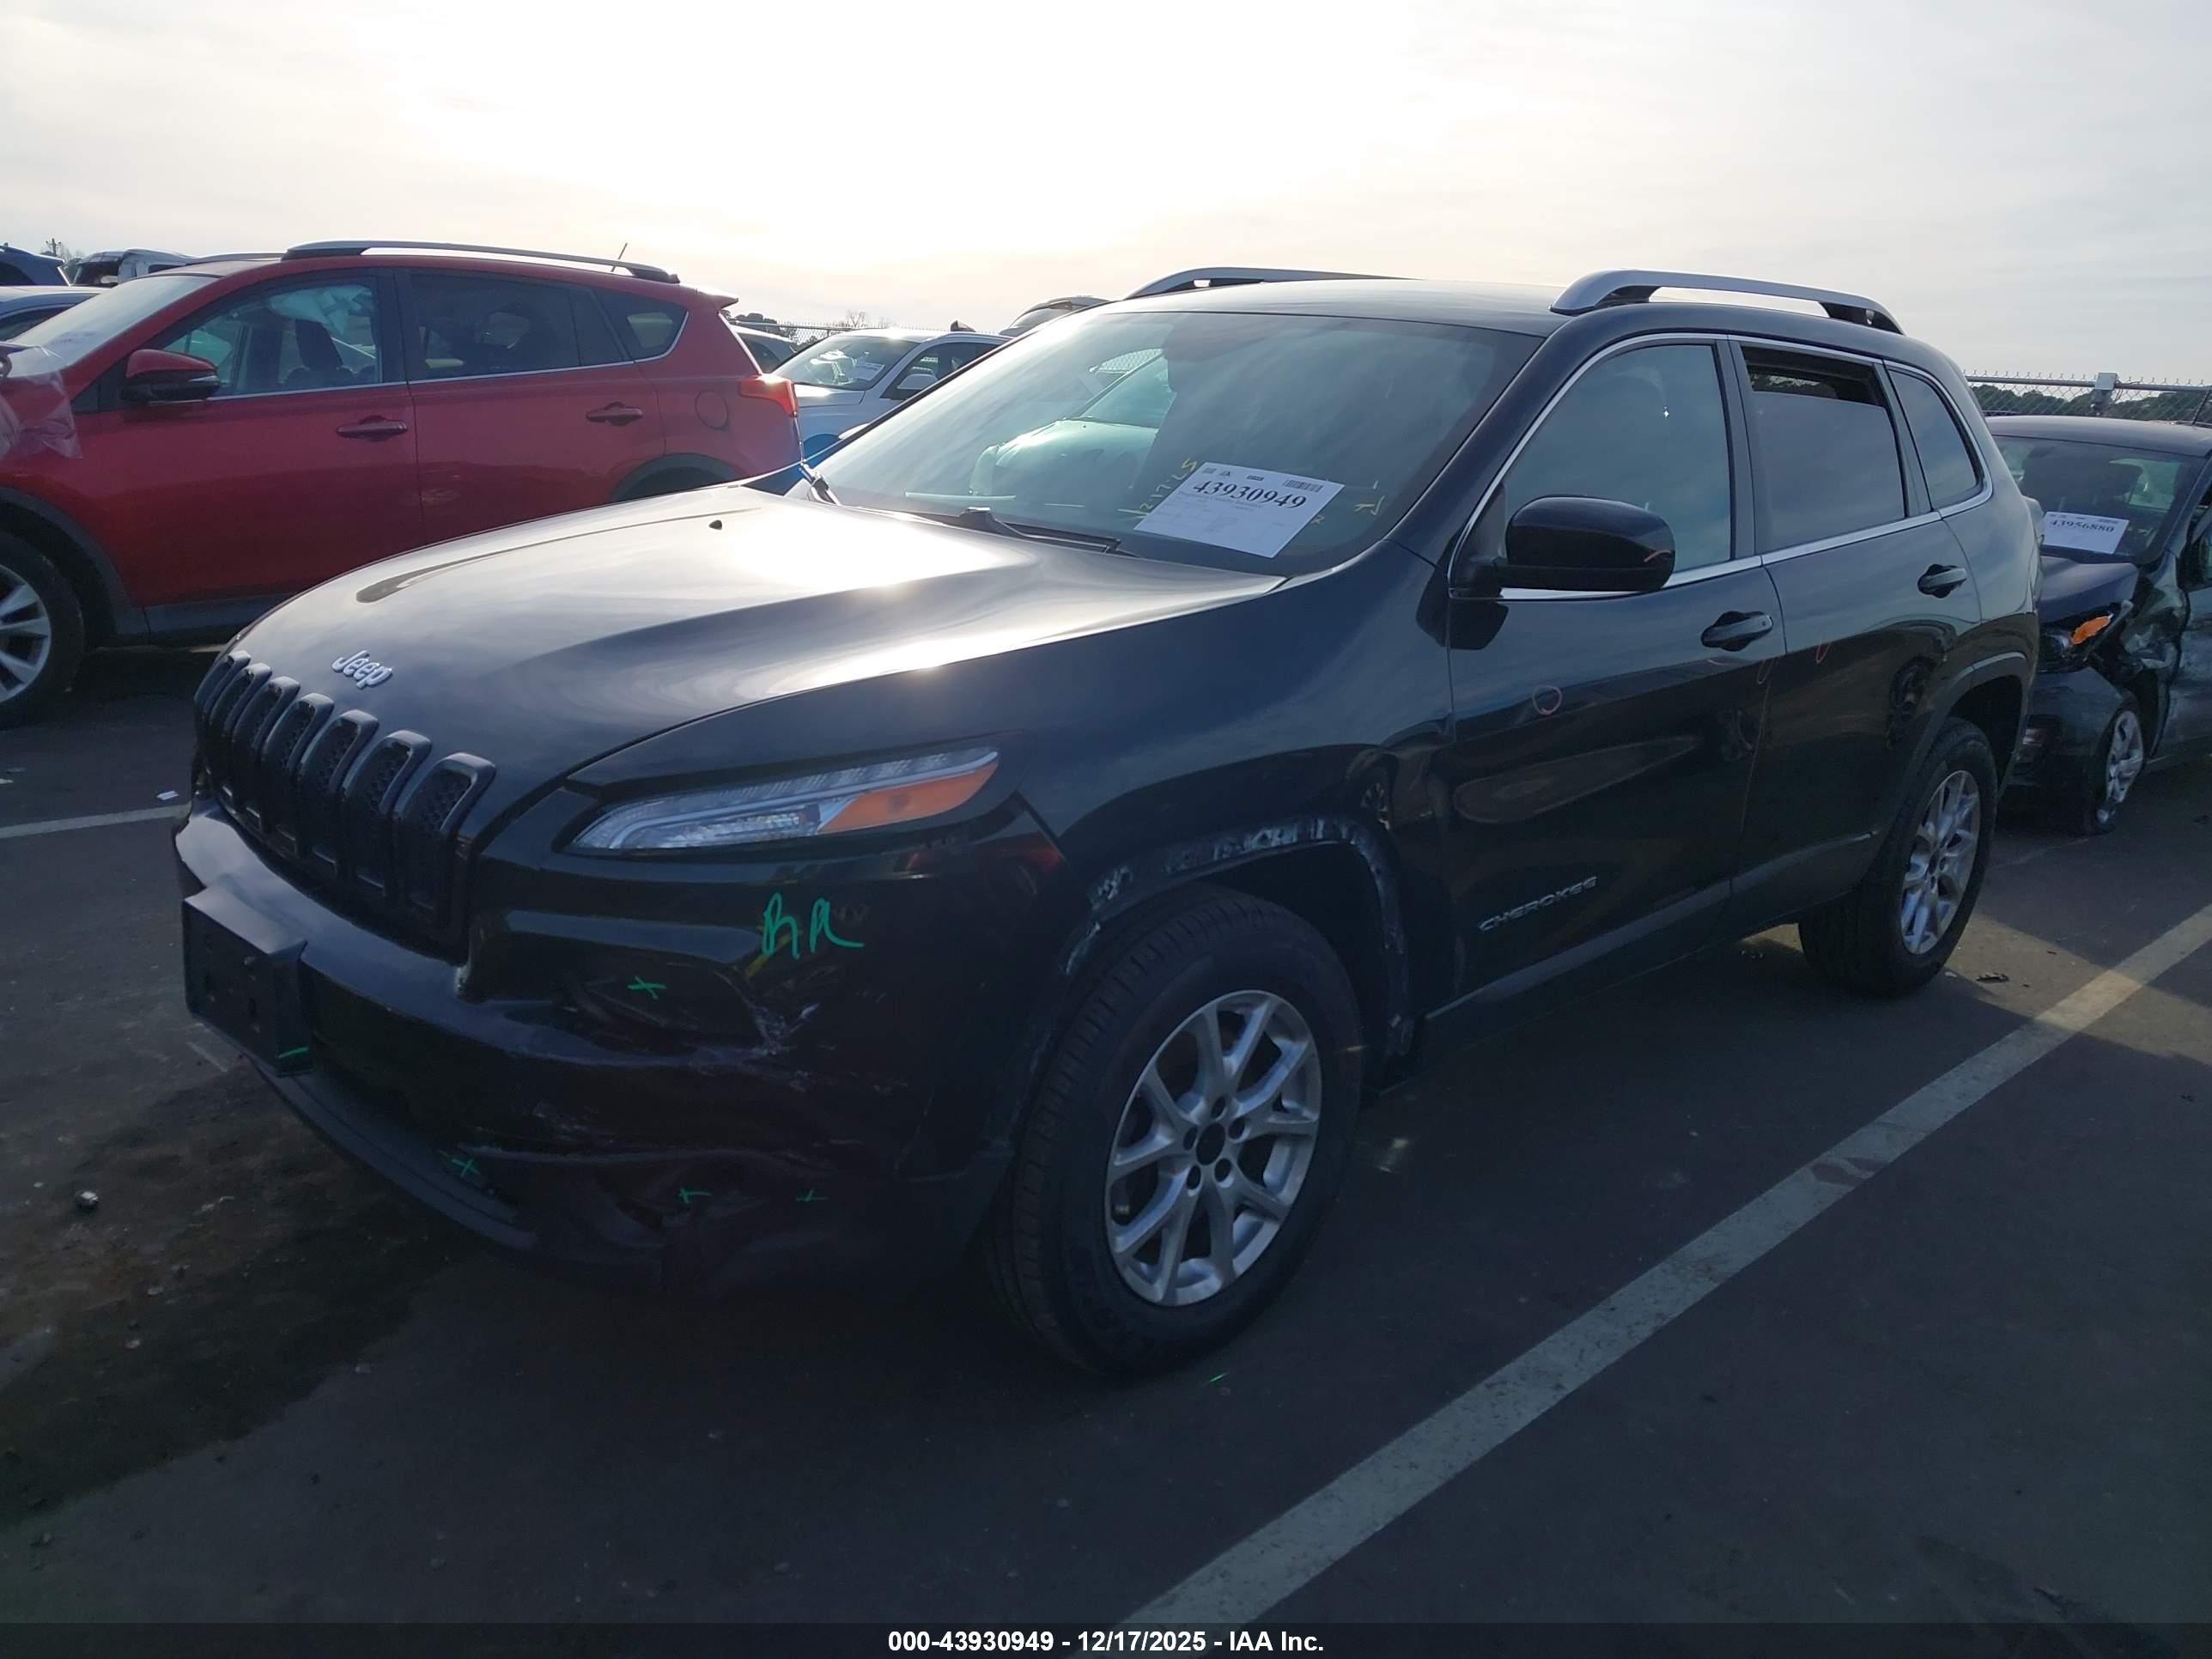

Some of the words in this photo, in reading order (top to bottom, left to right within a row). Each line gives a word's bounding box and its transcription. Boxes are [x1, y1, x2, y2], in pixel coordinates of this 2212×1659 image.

[1193, 479, 1308, 509] 43930949
[331, 650, 392, 689] Jeep
[1479, 876, 1597, 931] CHEROKEE
